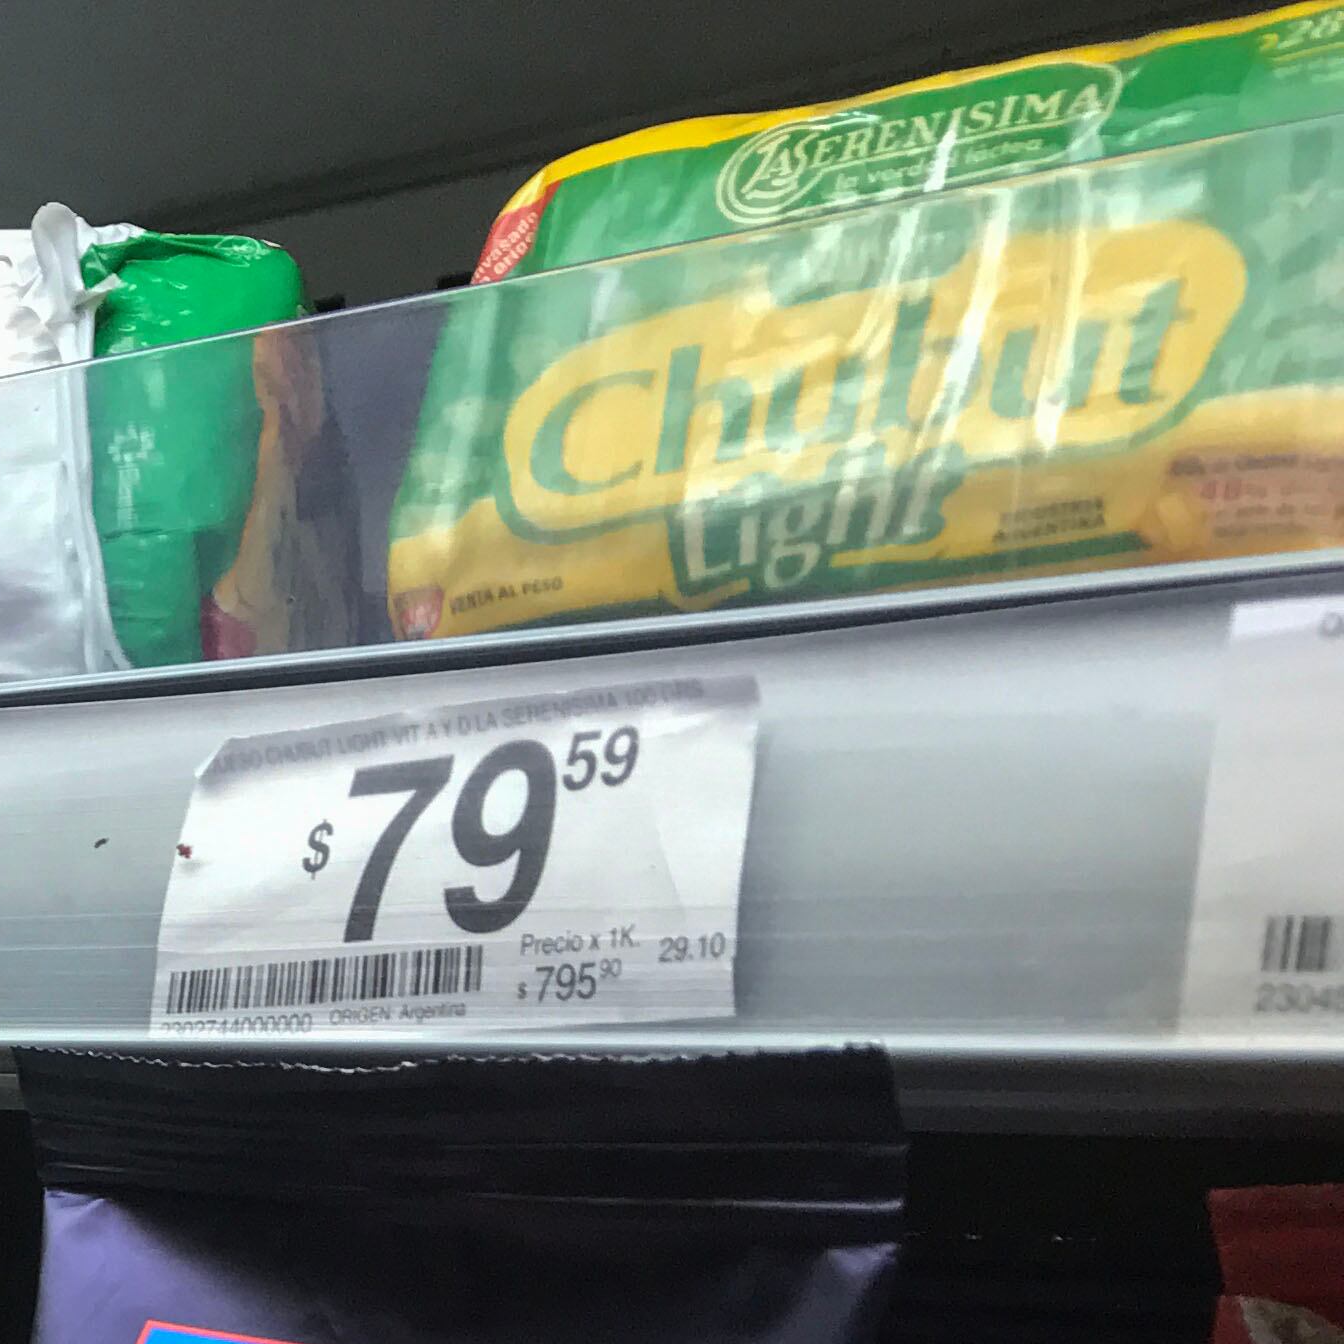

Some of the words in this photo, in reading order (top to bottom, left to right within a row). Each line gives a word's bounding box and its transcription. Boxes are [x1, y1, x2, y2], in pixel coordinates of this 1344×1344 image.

[301, 819, 334, 880] $
[343, 738, 558, 944] 79
[562, 725, 640, 793] 59
[519, 928, 584, 957] Precio
[589, 932, 601, 951] x
[657, 930, 728, 964] 29.10
[516, 980, 528, 1000] $
[534, 961, 598, 1004] 795
[599, 956, 623, 979] 90
[398, 1000, 468, 1025] Argentina
